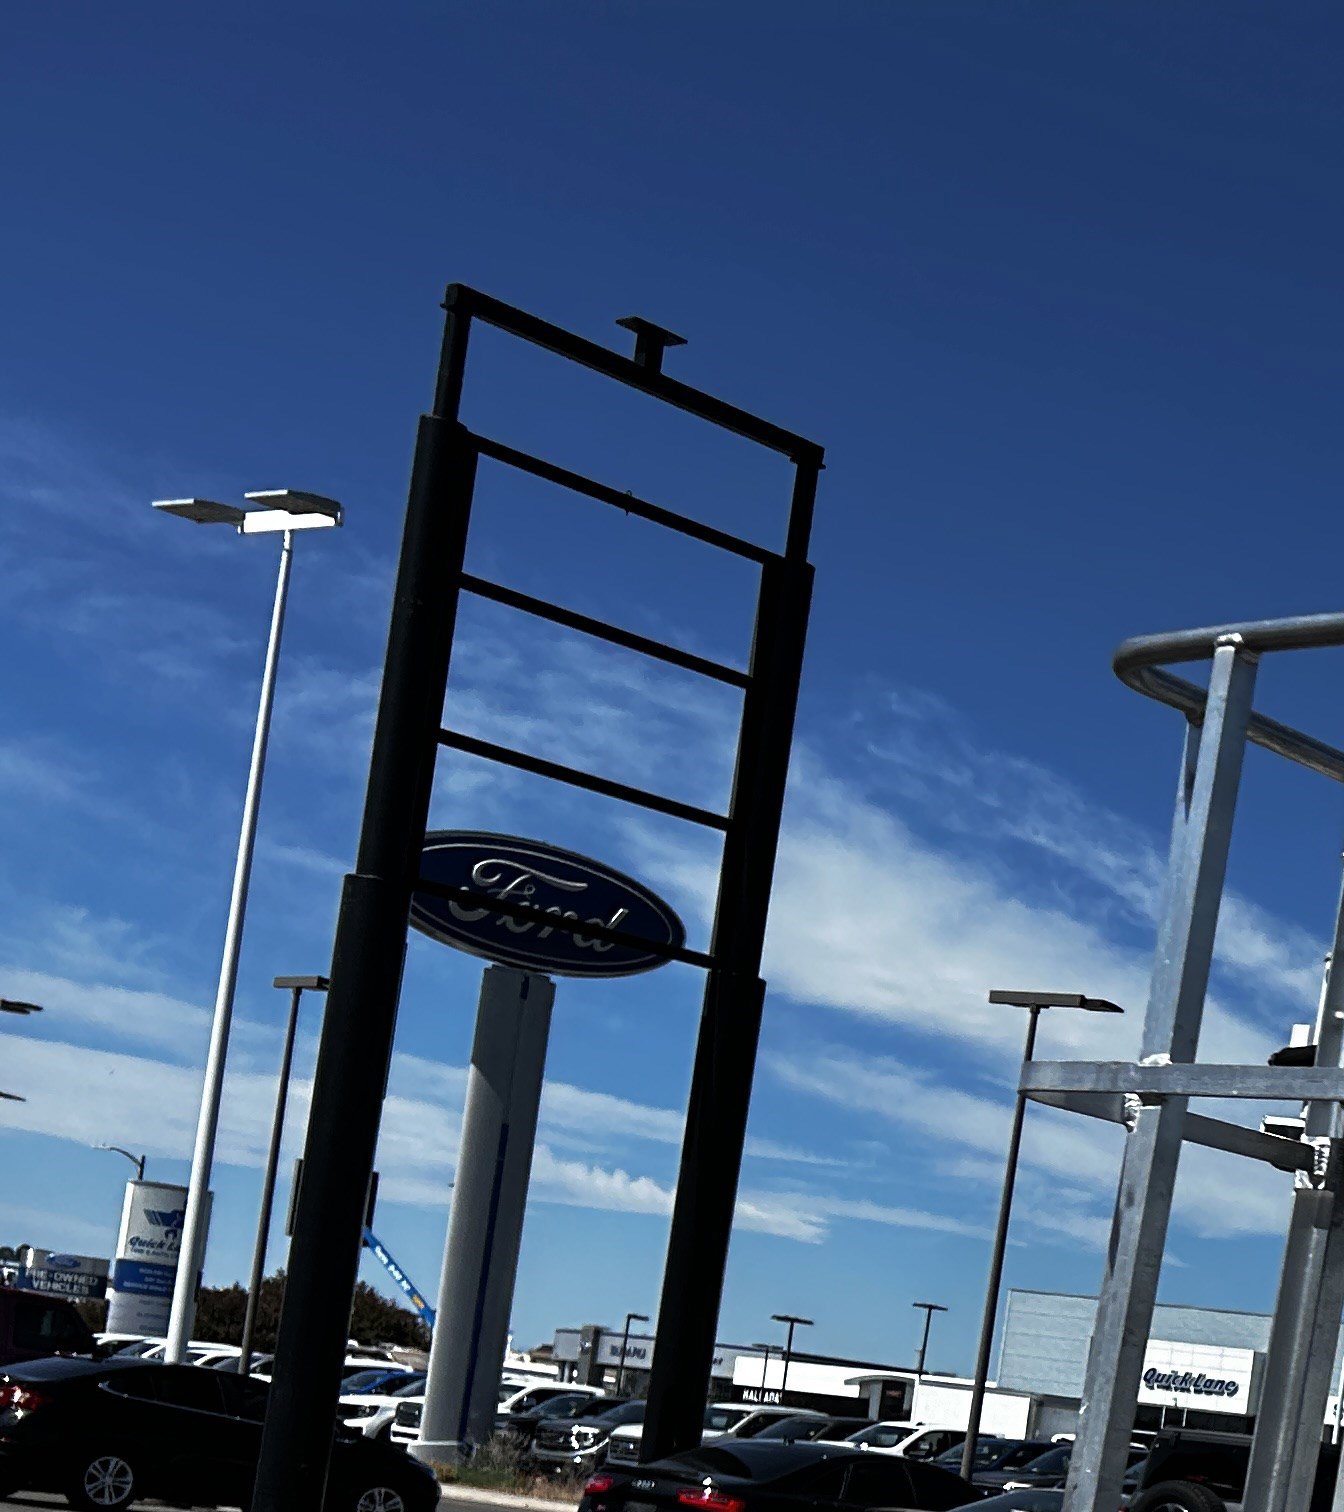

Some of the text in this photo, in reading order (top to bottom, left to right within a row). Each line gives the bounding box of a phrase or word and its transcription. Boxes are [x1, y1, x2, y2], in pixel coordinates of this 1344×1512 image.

[449, 859, 629, 952] Ford
[1143, 1368, 1238, 1394] Quick Lane
